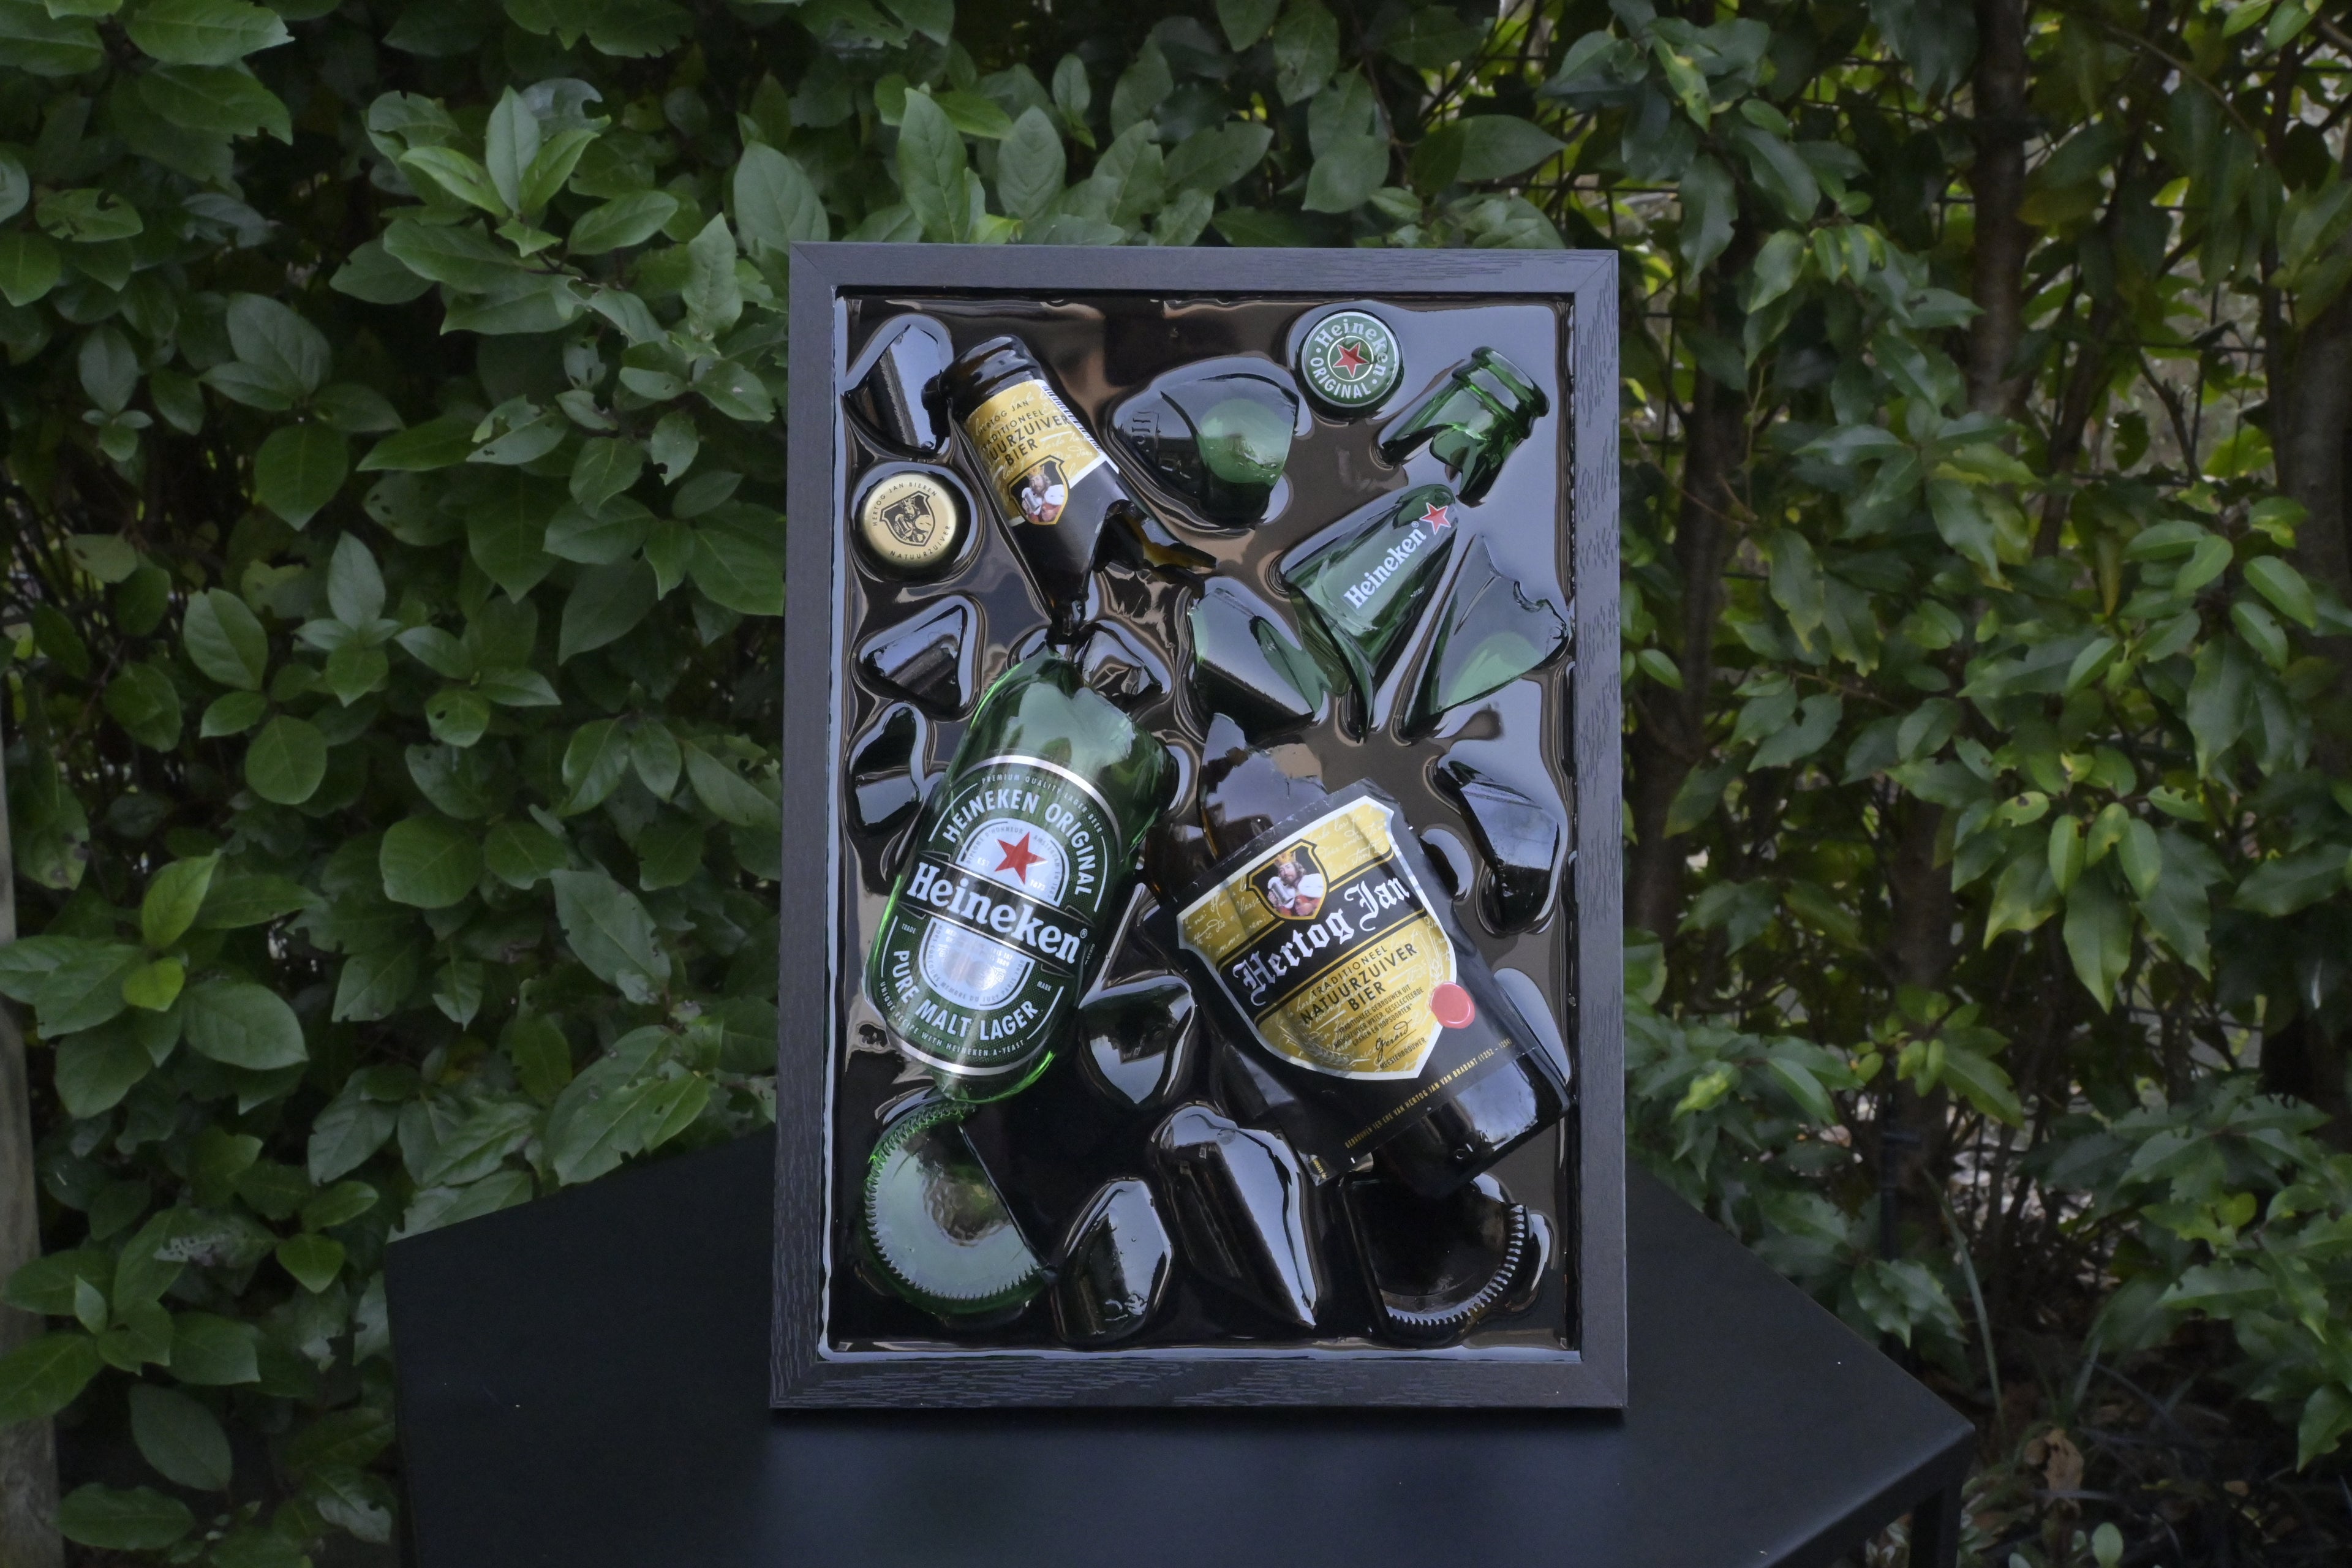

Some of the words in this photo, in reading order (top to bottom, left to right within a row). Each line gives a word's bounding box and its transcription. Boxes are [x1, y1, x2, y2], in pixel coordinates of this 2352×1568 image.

[1314, 318, 1388, 377] Heineken
[1310, 357, 1371, 399] ORIGINAL
[1012, 400, 1029, 412] JAN
[1005, 438, 1038, 466] BIER
[872, 494, 886, 526] HERTOG
[889, 483, 904, 493] JAN
[909, 482, 937, 496] BIEREN
[889, 526, 951, 559] NATUURZUIVER
[1343, 529, 1427, 609] Heineken
[982, 774, 1020, 784] PREMIUM
[1025, 776, 1061, 794] QUALITY
[1064, 793, 1088, 813] LAGER
[1088, 813, 1102, 833] BEER
[943, 788, 1040, 843] HEINEKEN
[1044, 803, 1096, 895] ORIGINAL
[907, 862, 1080, 964] Heineken
[901, 922, 917, 935] TRADE
[1036, 981, 1052, 992] MARK
[1232, 907, 1354, 1008] Hertog
[1344, 876, 1410, 932] Jan
[892, 951, 919, 1003] PURE
[915, 998, 972, 1038] MALT
[980, 1000, 1038, 1040] LAGER
[1300, 943, 1418, 1024] NATUURZUIVER
[1311, 946, 1388, 997] TRADITIONEEL
[1348, 981, 1386, 1012] BIER
[1371, 990, 1403, 1012] GEBROUWEN
[1401, 984, 1411, 993] UIT
[880, 981, 895, 1011] UNIQUE
[894, 1011, 919, 1034] RECIPE
[921, 1031, 943, 1047] WITH
[946, 1043, 989, 1056] HEINEKEN
[1385, 987, 1424, 1014] GESELECTEERDE
[1352, 1031, 1372, 1047] GRANEN
[1372, 1025, 1380, 1034] EN
[1380, 1037, 1427, 1070] MEESTERBROUWER
[1393, 1104, 1405, 1116] VAN
[1404, 1090, 1428, 1109] HERTOG
[1428, 1082, 1440, 1093] JAN
[1439, 1074, 1453, 1085] VAN
[1452, 1058, 1479, 1078] BRABANT
